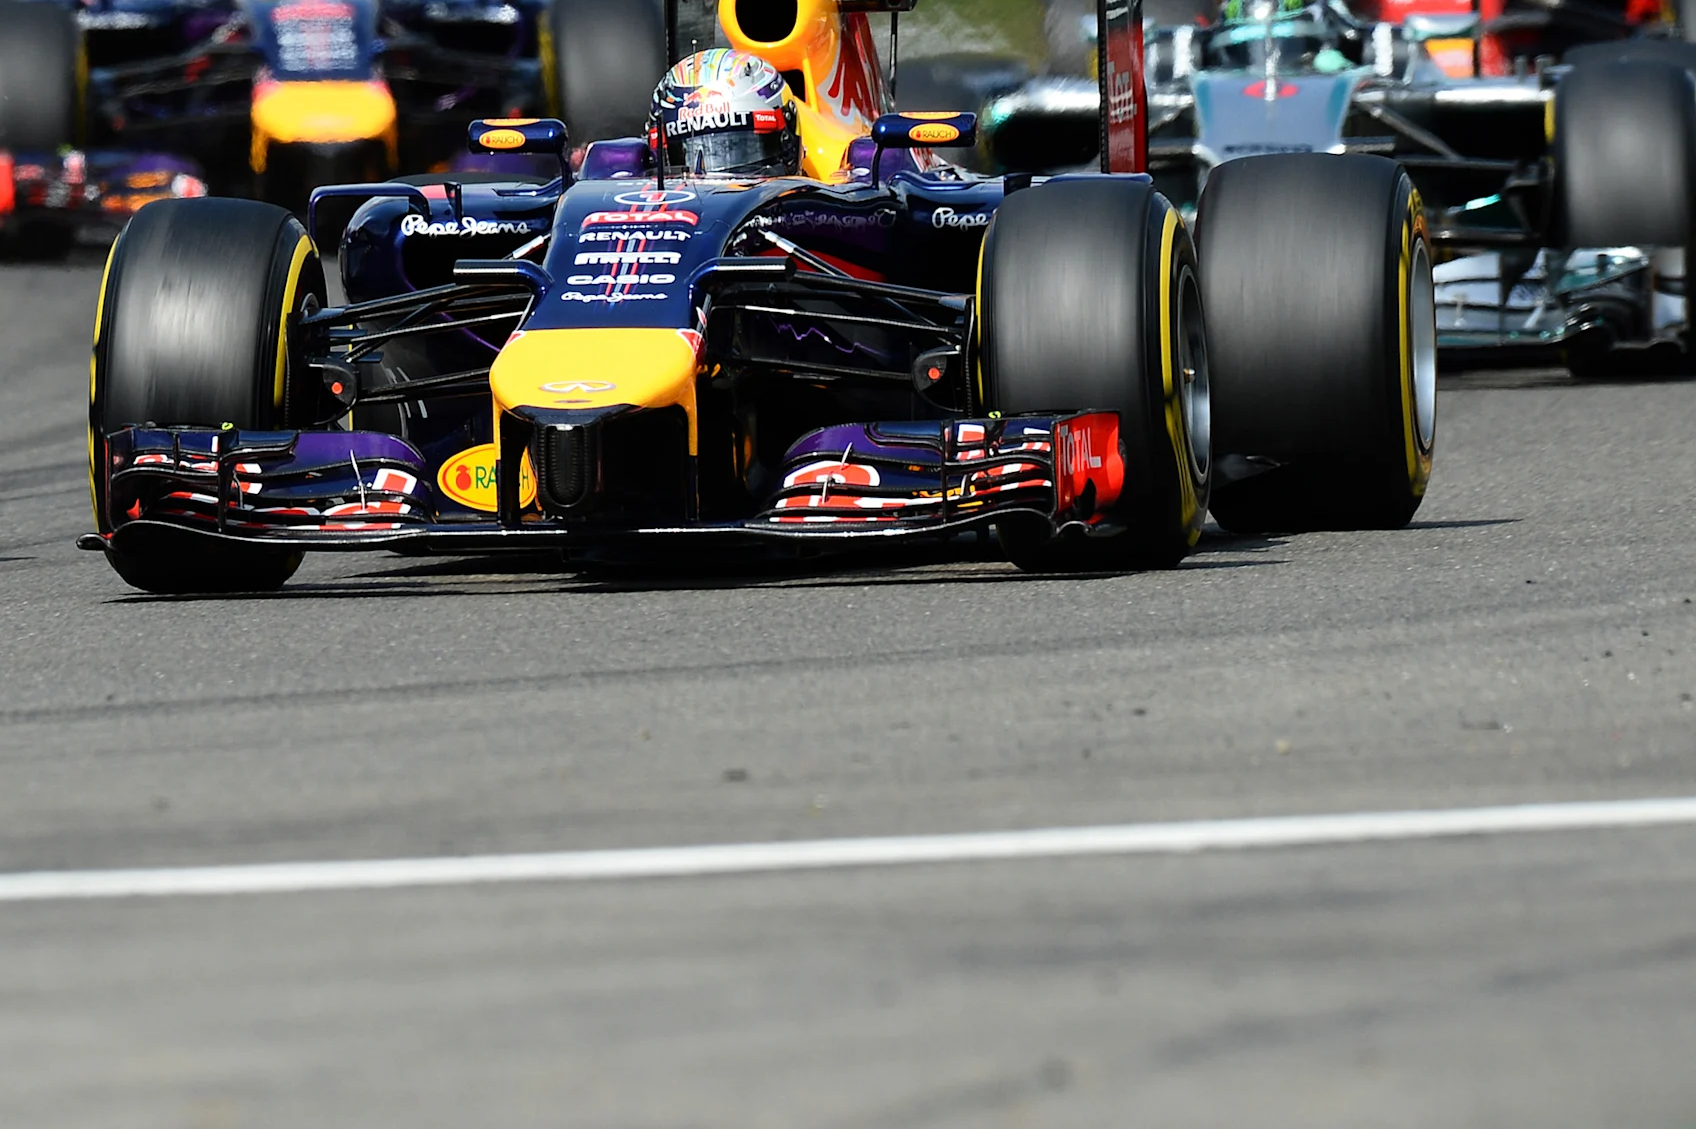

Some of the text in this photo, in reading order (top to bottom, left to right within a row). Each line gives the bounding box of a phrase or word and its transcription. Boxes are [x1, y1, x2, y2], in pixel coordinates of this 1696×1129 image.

[755, 113, 777, 122] TOTAL
[666, 111, 751, 138] RENAULT
[923, 130, 952, 138] RAUCH
[492, 136, 519, 145] RAUCH
[589, 212, 695, 223] TOTAL
[401, 214, 531, 239] Pepe Jeans
[578, 230, 691, 243] RENAULT
[567, 274, 676, 285] CASIO
[561, 291, 668, 303] Pepe Jeans
[1060, 424, 1102, 477] TOTAL
[475, 465, 530, 490] RAH
